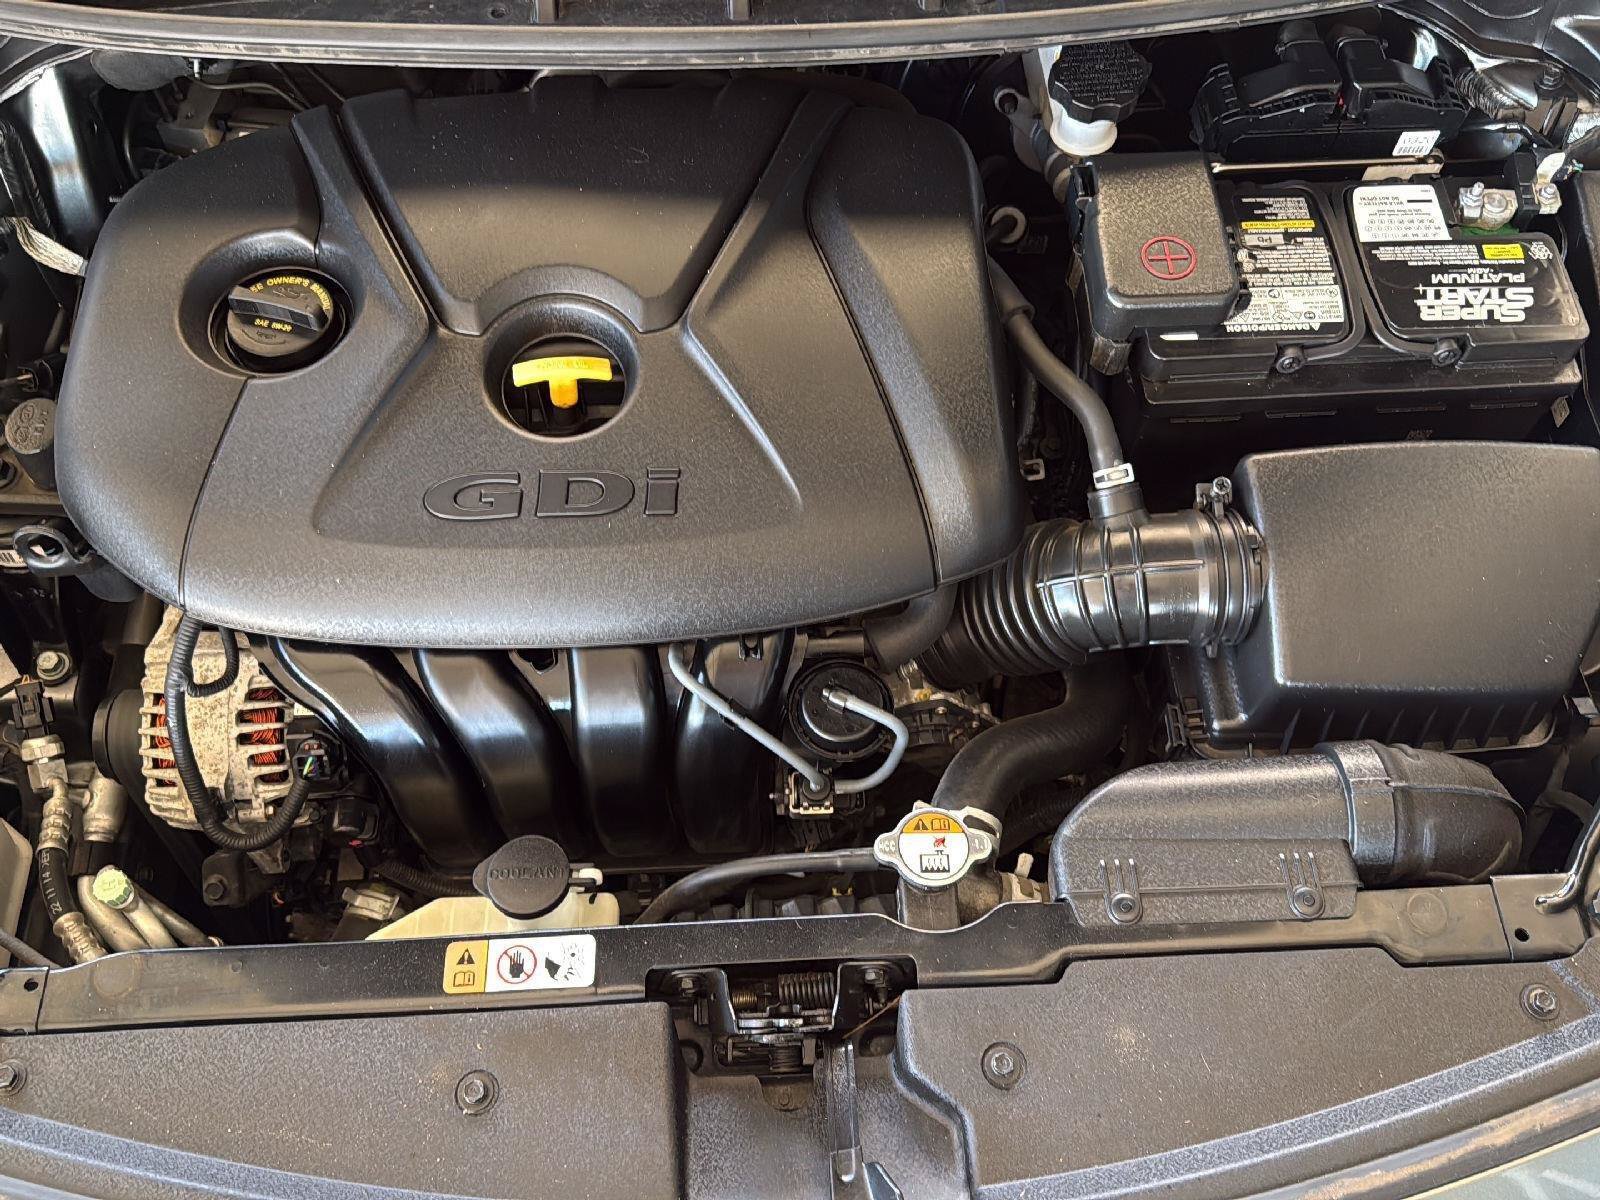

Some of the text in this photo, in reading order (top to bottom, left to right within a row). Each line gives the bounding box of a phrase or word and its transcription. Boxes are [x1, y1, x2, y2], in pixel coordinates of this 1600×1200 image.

[266, 276, 310, 287] OWNER'S
[1431, 273, 1526, 284] PLATINUM
[1414, 286, 1534, 308] START
[1420, 303, 1526, 322] SUPER
[254, 318, 270, 328] SAE
[423, 467, 681, 520] GDi
[489, 864, 565, 881] COOLANT
